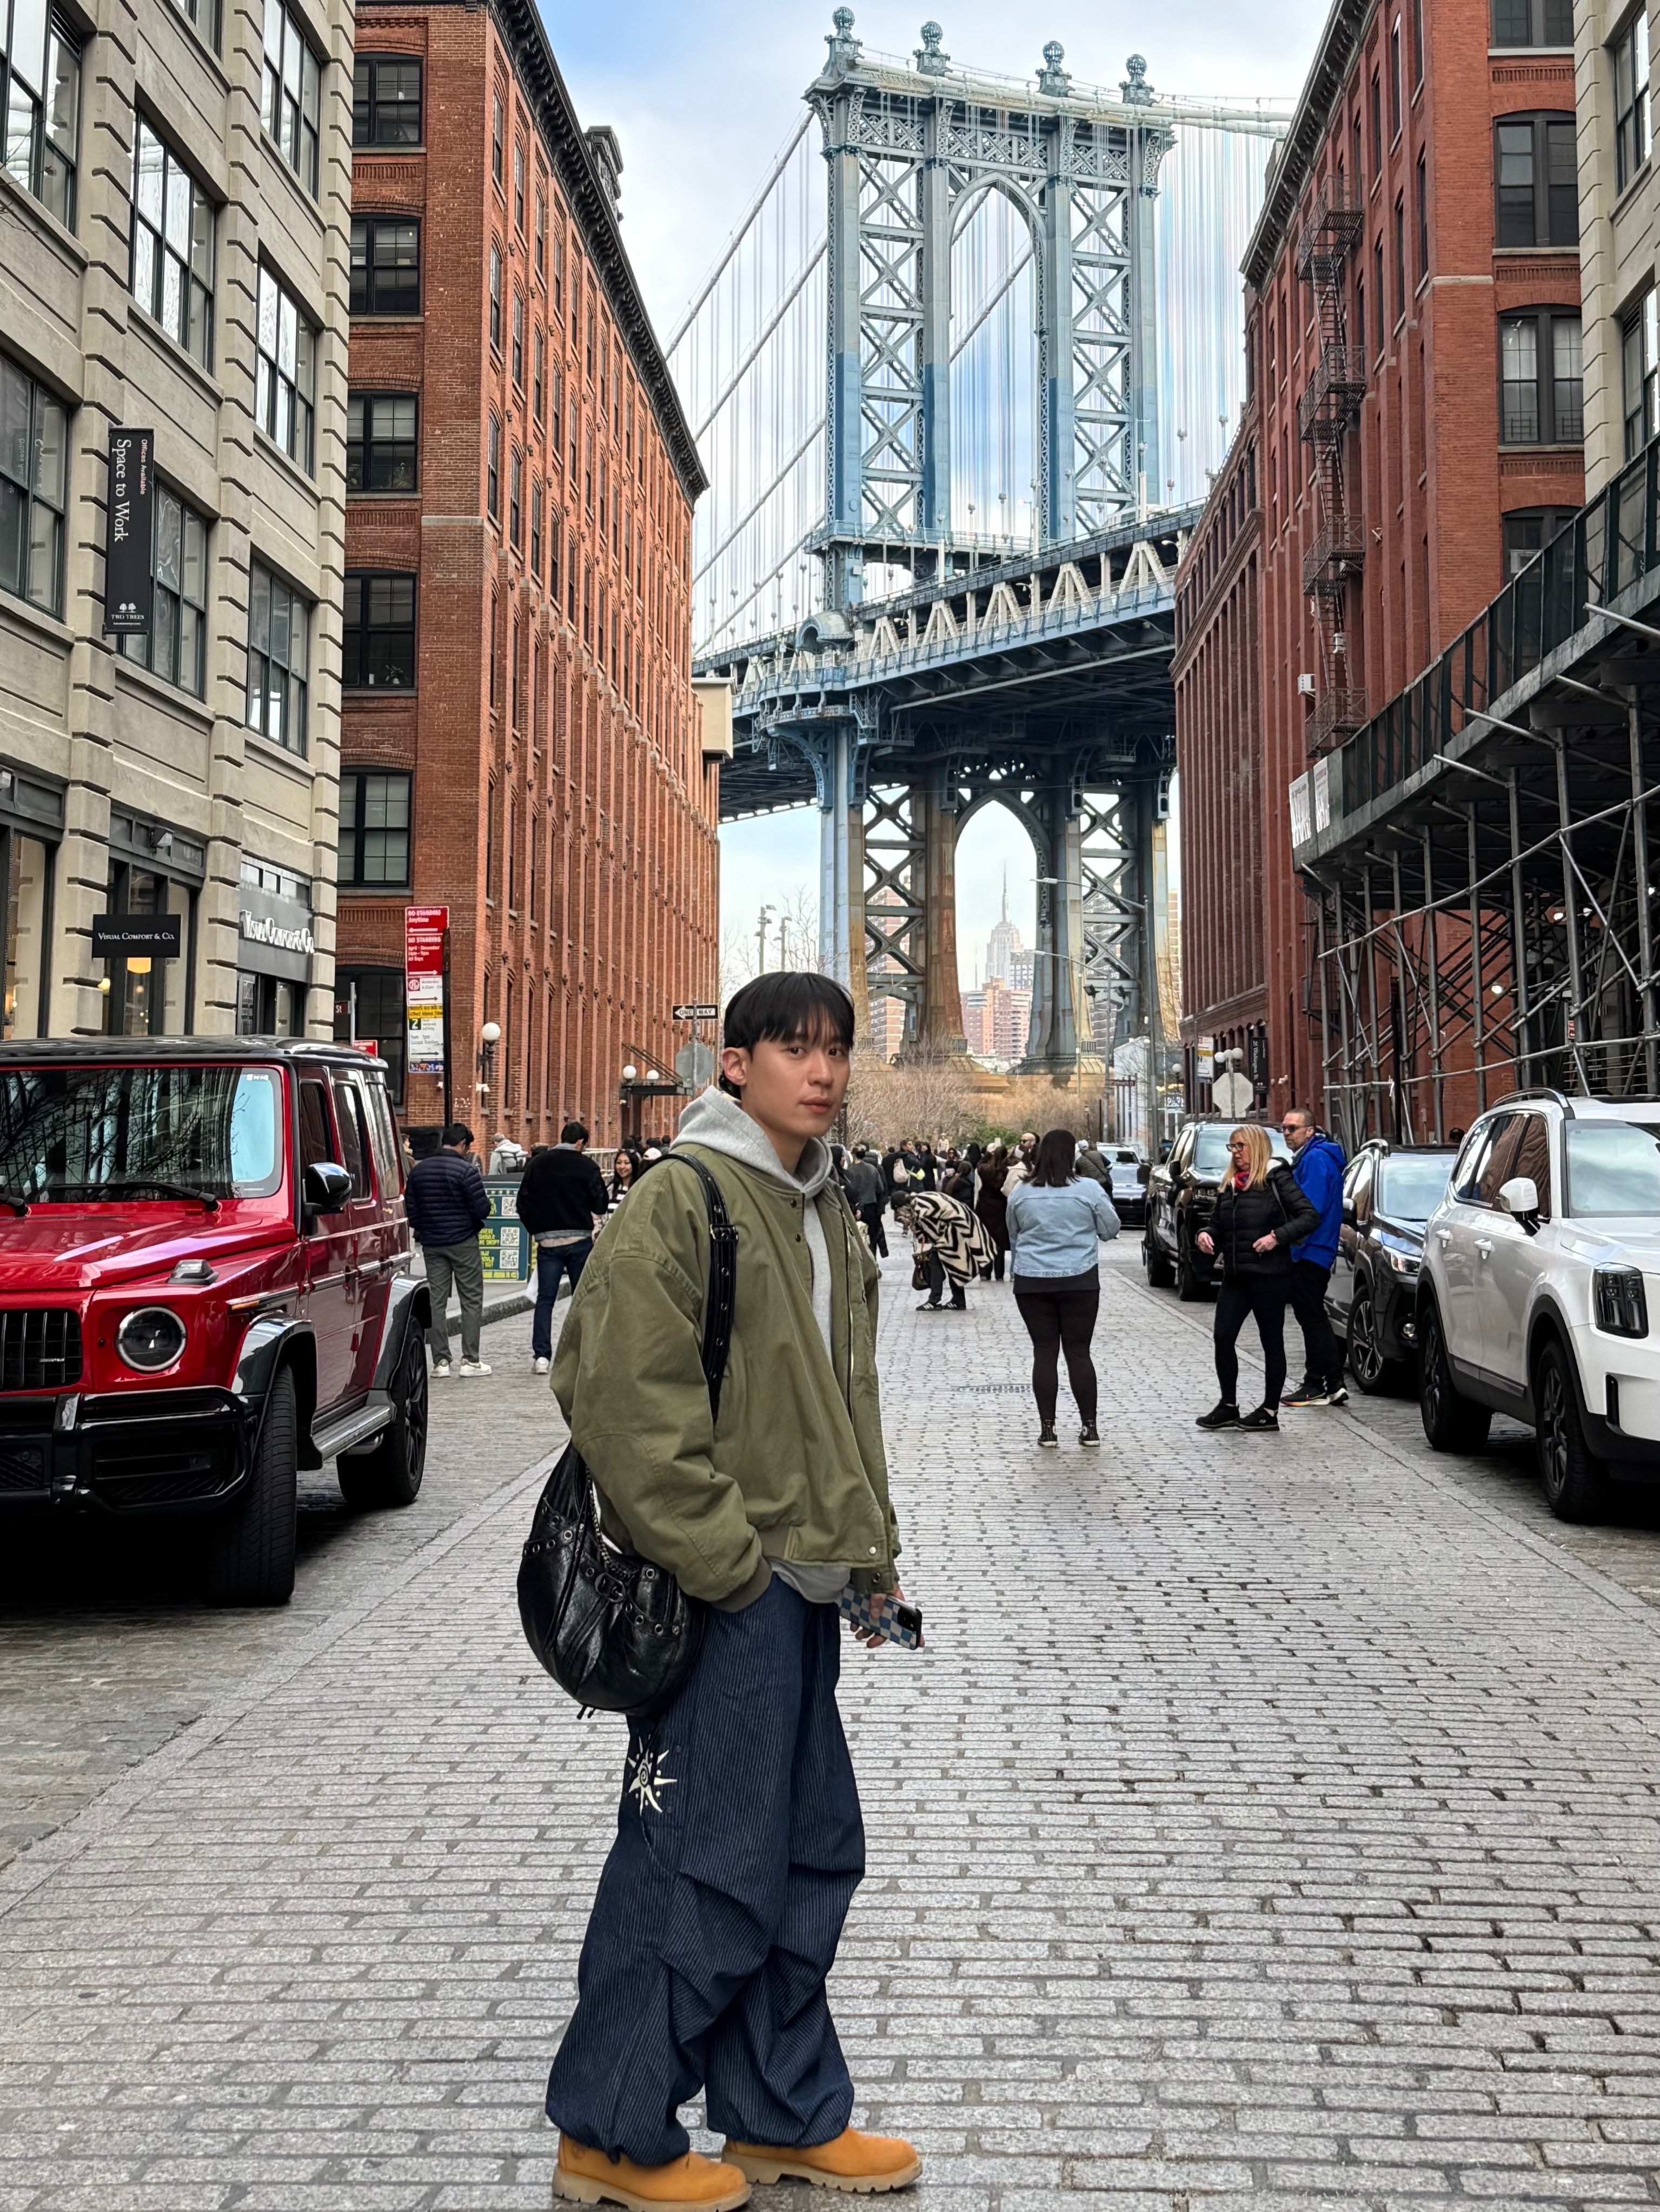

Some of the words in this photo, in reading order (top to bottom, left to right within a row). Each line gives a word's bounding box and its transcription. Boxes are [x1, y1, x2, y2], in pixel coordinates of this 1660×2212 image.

[112, 439, 131, 478] Space
[116, 483, 127, 497] to
[115, 501, 130, 542] Work
[411, 1018, 419, 1029] 2
